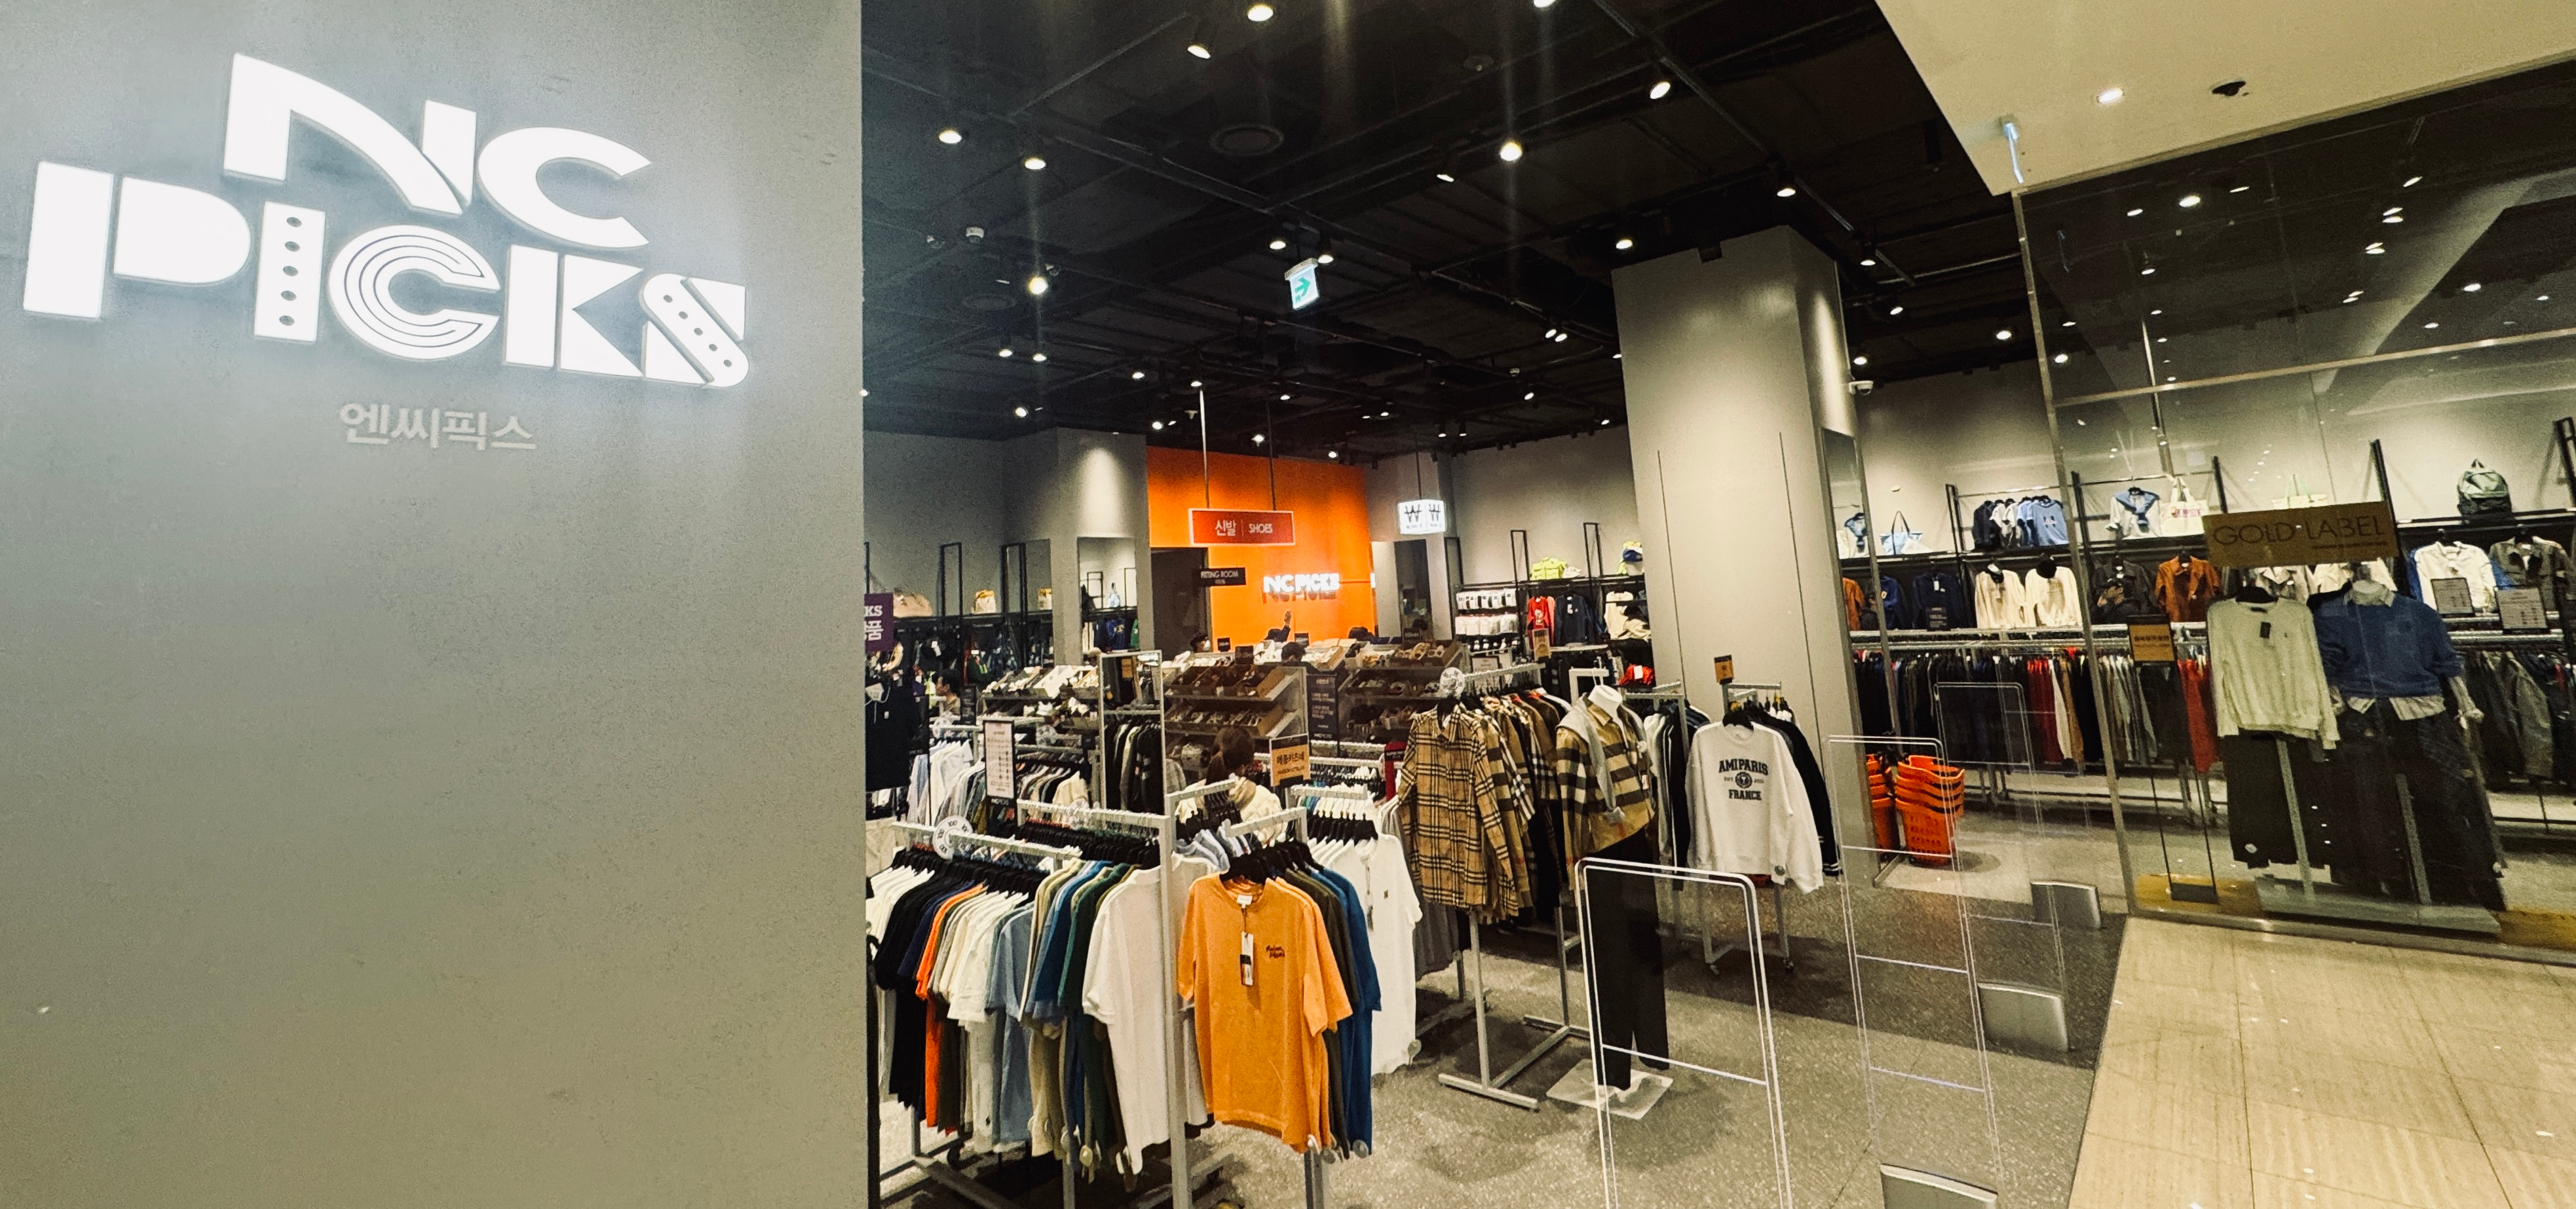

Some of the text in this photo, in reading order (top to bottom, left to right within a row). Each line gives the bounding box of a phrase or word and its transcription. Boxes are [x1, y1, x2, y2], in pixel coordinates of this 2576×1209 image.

[223, 52, 653, 250] NC
[24, 160, 750, 388] PICKS
[339, 401, 537, 452] 엔씨픽스
[1215, 519, 1274, 536] 신발 SHOES
[2213, 515, 2385, 546] GOLD LABEL
[1221, 570, 1239, 578] ROOM
[1263, 572, 1340, 593] NC PICKS
[865, 620, 884, 641] 품
[1718, 758, 1769, 776] AMI PARIS
[1728, 789, 1762, 801] FRANCE
